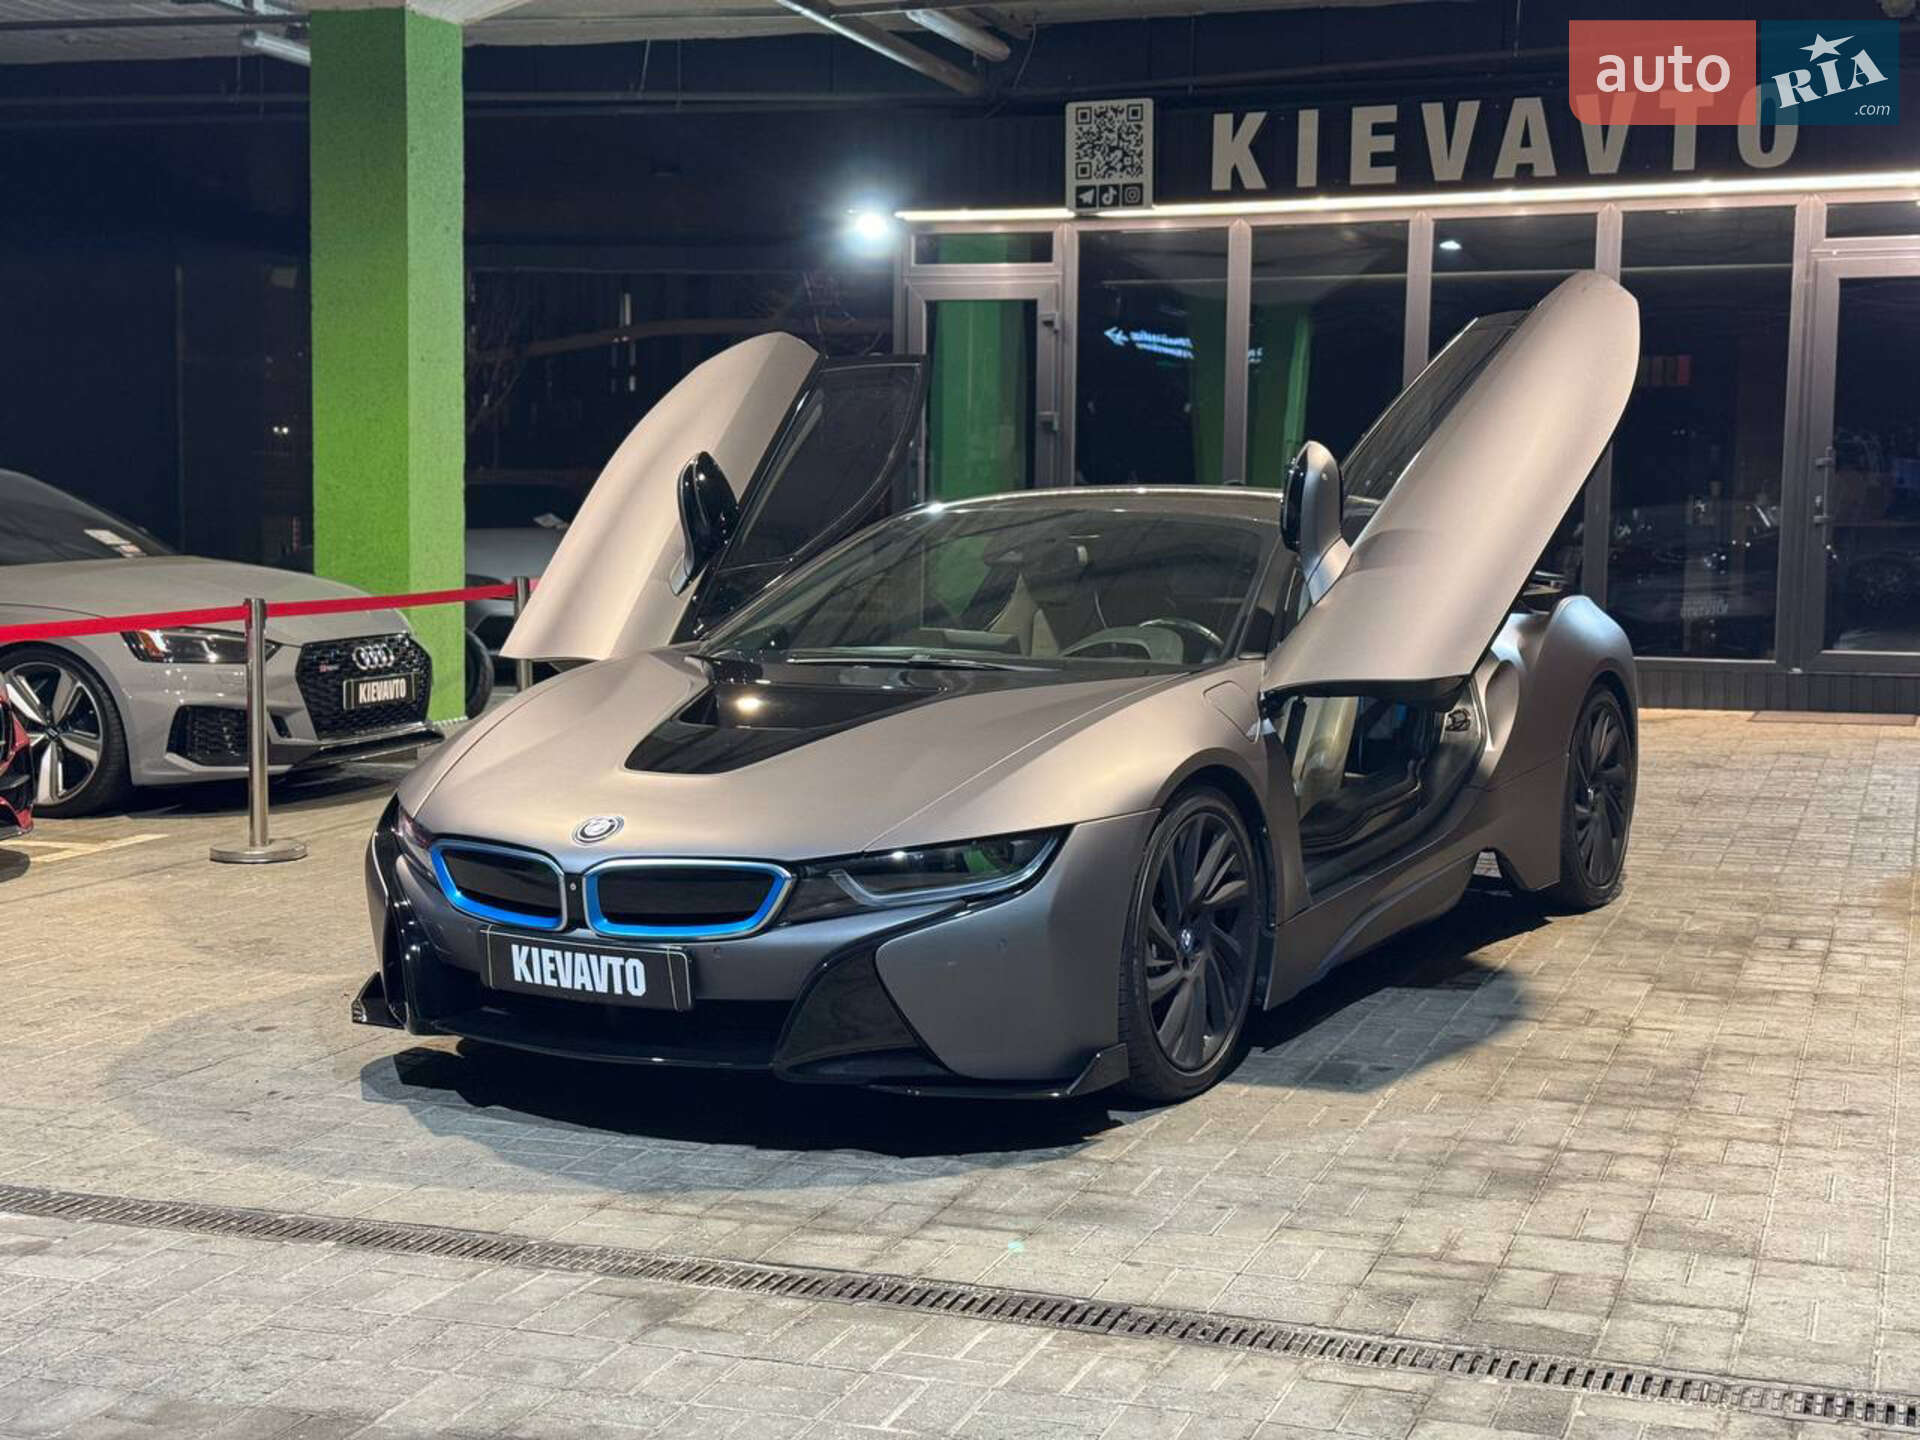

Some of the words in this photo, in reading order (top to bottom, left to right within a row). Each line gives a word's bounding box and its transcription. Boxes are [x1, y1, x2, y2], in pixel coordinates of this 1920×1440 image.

[1211, 82, 1799, 191] KIEVAVTO
[359, 677, 407, 704] KIEVAVTO
[511, 944, 647, 997] KIEVAVTO
